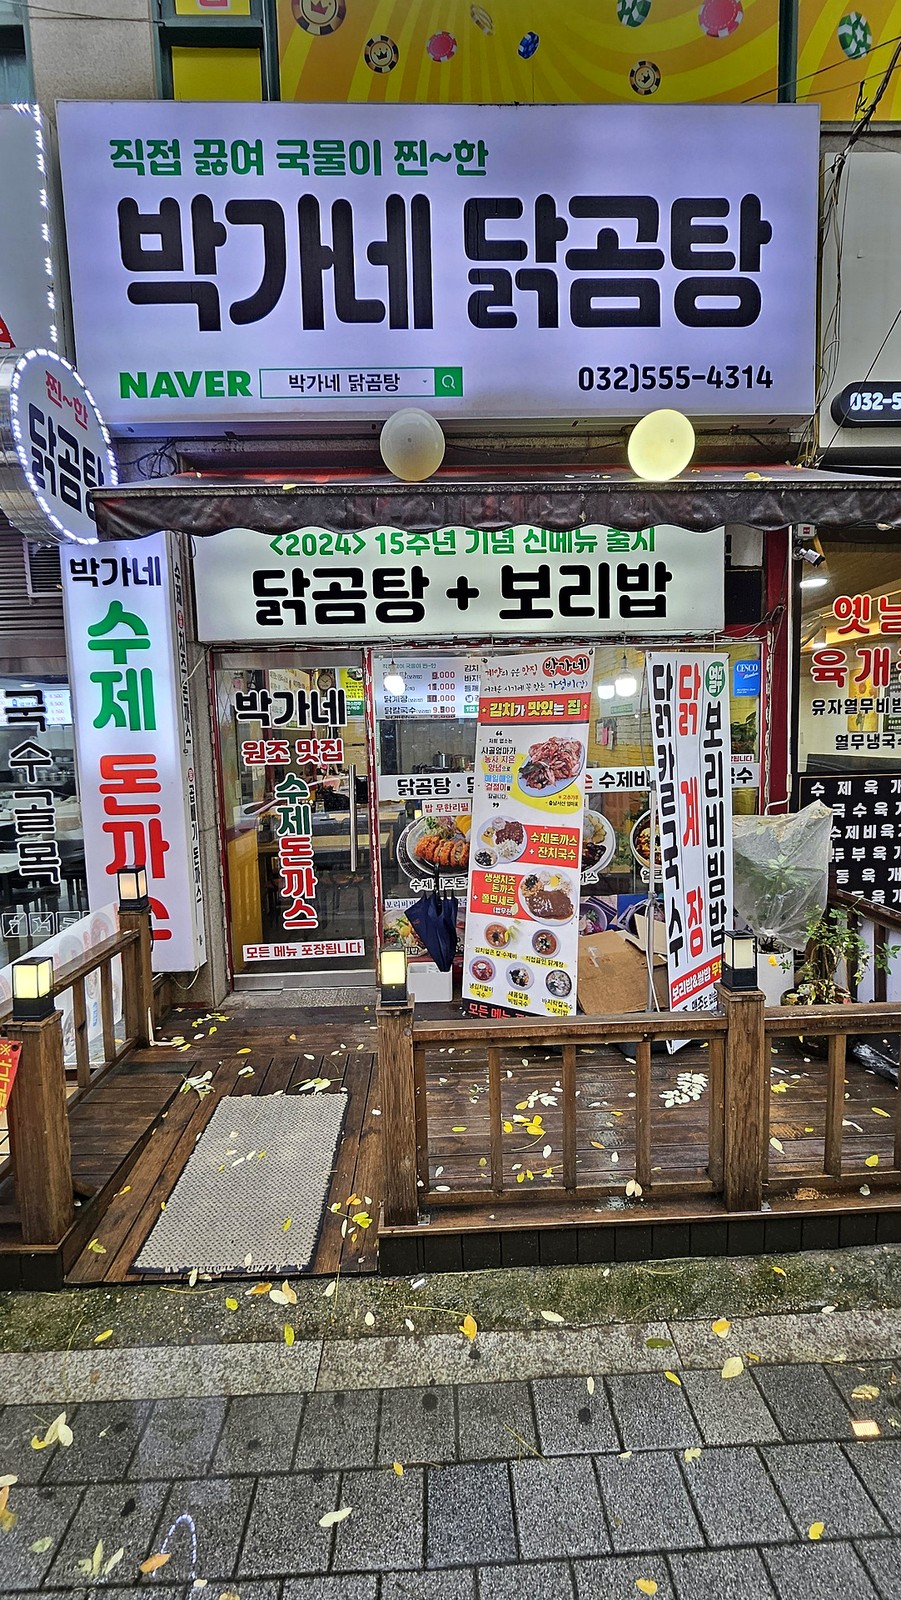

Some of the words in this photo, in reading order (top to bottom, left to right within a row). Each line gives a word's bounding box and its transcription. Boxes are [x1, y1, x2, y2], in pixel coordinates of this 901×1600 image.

[109, 139, 182, 176] 직접
[194, 139, 264, 176] 끓여
[276, 139, 383, 176] 국물이
[394, 139, 489, 176] 찐~한
[116, 193, 434, 331] 박가네
[462, 193, 773, 330] 닭곰탕
[120, 371, 251, 399] NAVER
[289, 373, 341, 393] 박가네
[346, 372, 401, 393] 닭곰탕
[577, 364, 774, 393] 032)555-4314
[45, 370, 88, 430] 찐~한
[269, 531, 366, 556] <2024>
[374, 531, 457, 556] 15주년
[466, 530, 514, 555] 기념
[523, 529, 597, 555] 신메뉴
[70, 556, 162, 587] 박가네
[252, 565, 430, 625] 닭곰탕
[499, 561, 672, 620] 보리밥
[87, 600, 157, 732] 수제
[545, 657, 587, 675] 박가네
[736, 663, 758, 673] CESCO
[811, 647, 901, 688] 육개
[236, 690, 347, 727] 박가네
[489, 702, 525, 717] 김치가
[528, 700, 564, 716] 맛있는
[567, 699, 581, 715] 집
[242, 740, 291, 766] 원조
[296, 738, 344, 764] 맛집
[835, 733, 901, 751] 열무냉국
[5, 689, 61, 884] 국수골목
[397, 777, 451, 796] 닭곰탕
[425, 803, 432, 814] 밥
[435, 802, 469, 813] 무한리필
[652, 662, 684, 968] 닭칼국수
[703, 700, 727, 949] 보리비빔밥
[530, 832, 577, 846] 수제돈까스
[538, 846, 576, 861] 잔치국수
[484, 873, 516, 885] 생생치즈
[492, 884, 515, 895] 돈까스
[246, 946, 270, 960] 모든
[274, 944, 297, 958] 메뉴
[301, 941, 362, 956] 포장됩니다
[469, 1003, 488, 1018] 모든
